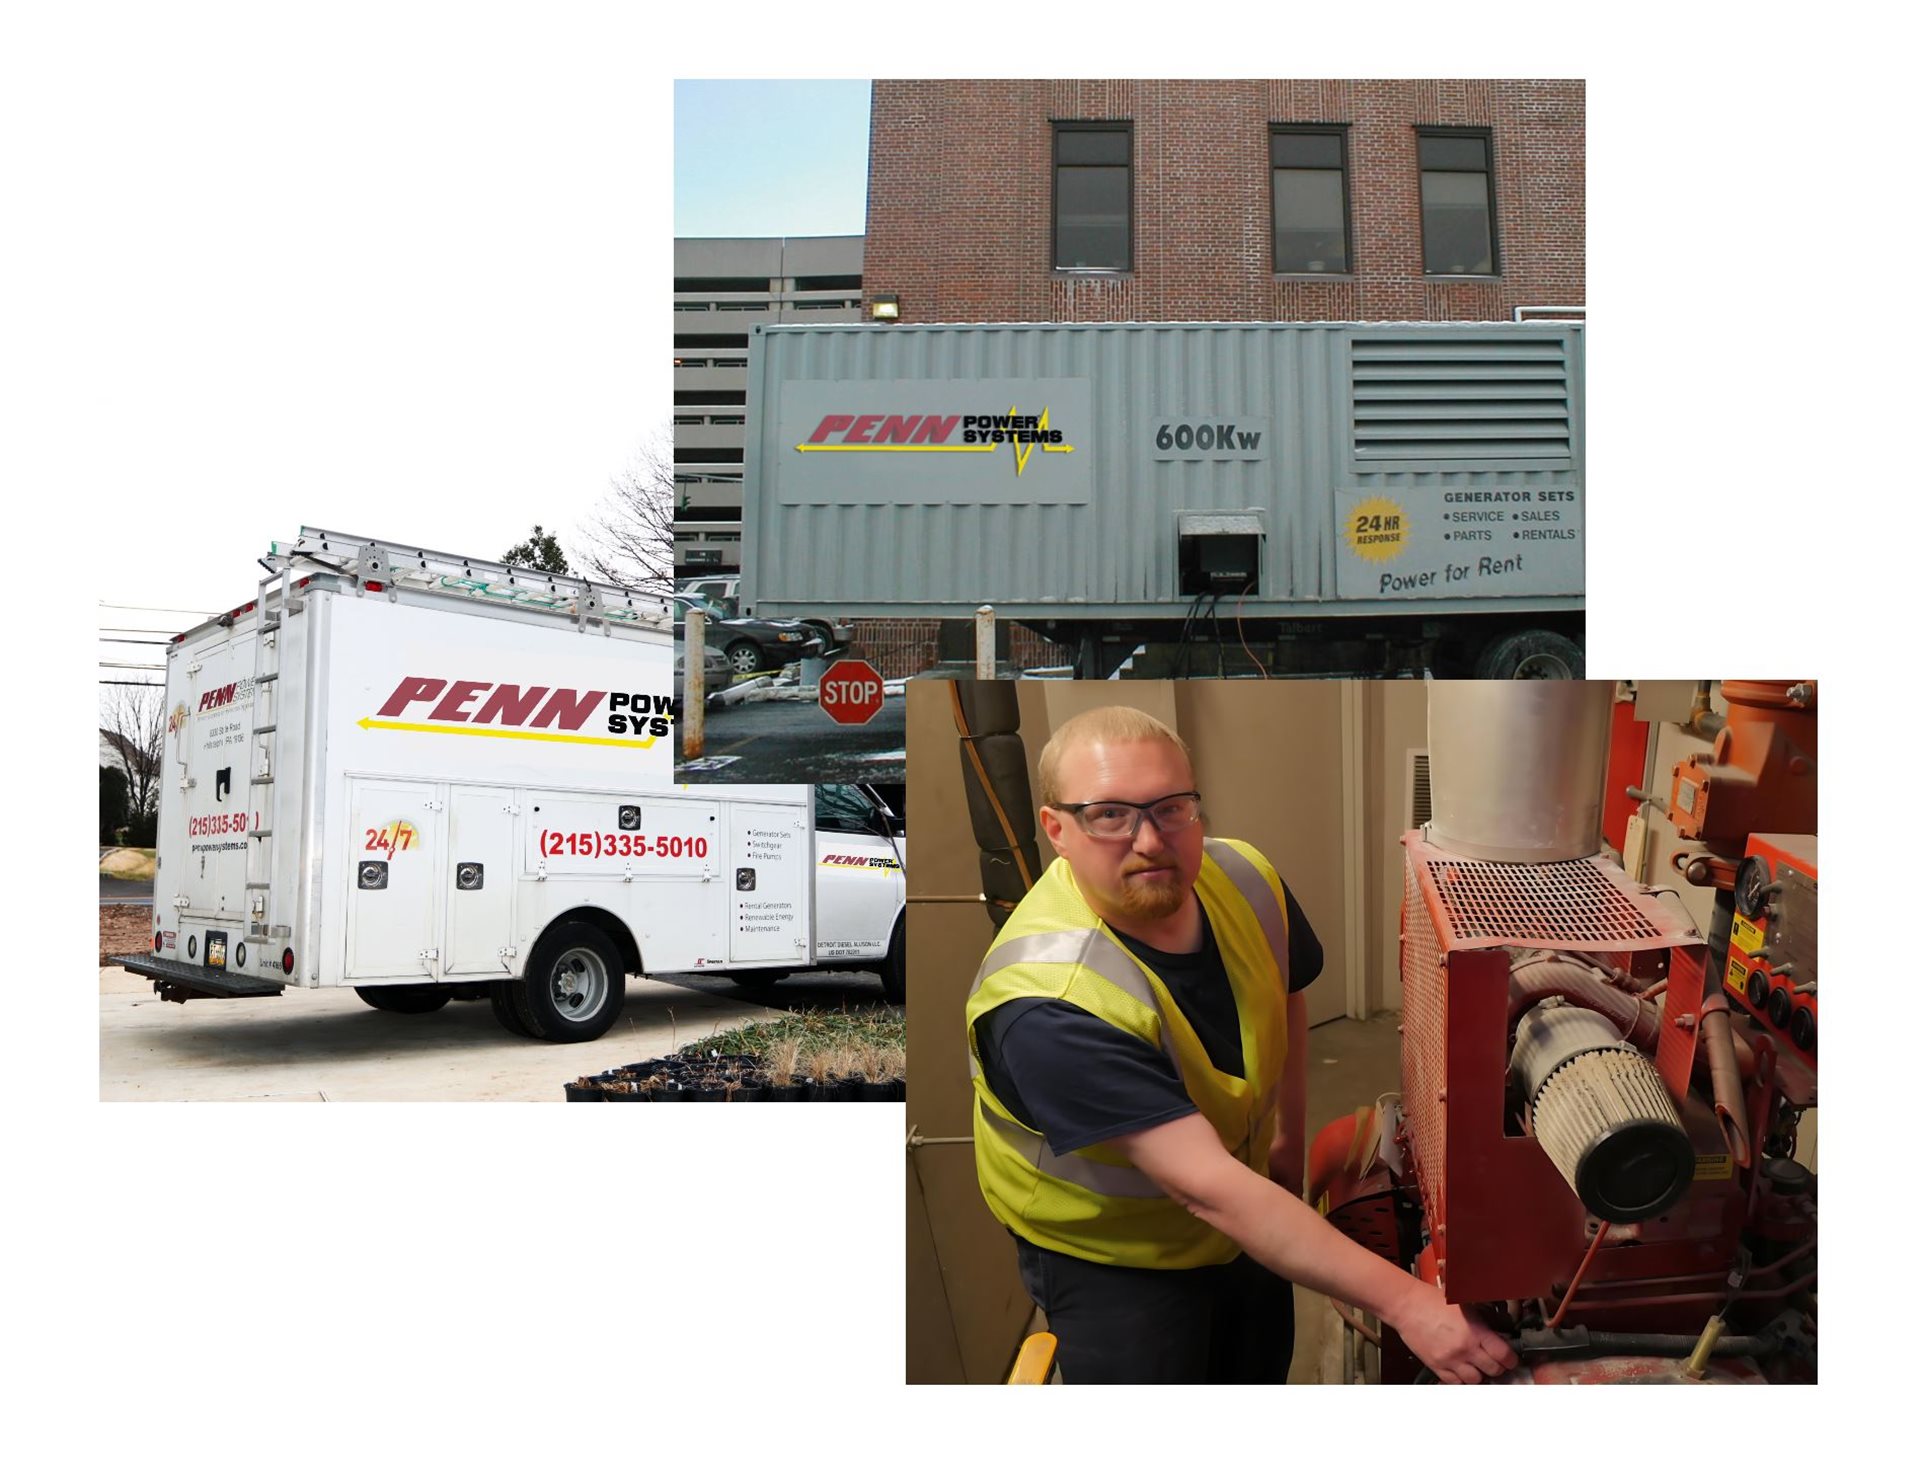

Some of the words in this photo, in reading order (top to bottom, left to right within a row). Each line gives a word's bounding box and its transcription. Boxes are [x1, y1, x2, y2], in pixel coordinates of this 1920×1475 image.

[963, 415, 1039, 429] POWER
[809, 415, 961, 444] PENN
[963, 429, 1063, 443] SYSTEMS
[1444, 491, 1531, 502] GENERATOR
[1538, 490, 1575, 501] SETS
[1452, 511, 1505, 521] SERVICE
[1521, 511, 1560, 521] SALES
[1356, 515, 1382, 533] 24
[1384, 516, 1399, 531] HR
[1357, 533, 1400, 544] RESPONSE
[1453, 530, 1492, 541] PARTS
[1522, 529, 1576, 540] RENTALS
[1380, 573, 1437, 593] Power
[1445, 564, 1470, 582] for
[1479, 554, 1523, 576] Rent
[198, 682, 237, 713] PENN
[824, 681, 879, 705] STOP
[376, 676, 608, 730] PENN
[608, 714, 674, 737] SYS
[366, 820, 412, 860] 24/7
[752, 829, 779, 838] Generator
[540, 829, 707, 858] (215)335-5010
[752, 840, 781, 850] Switchgear
[822, 854, 869, 866] PENN
[763, 902, 792, 910] Generators
